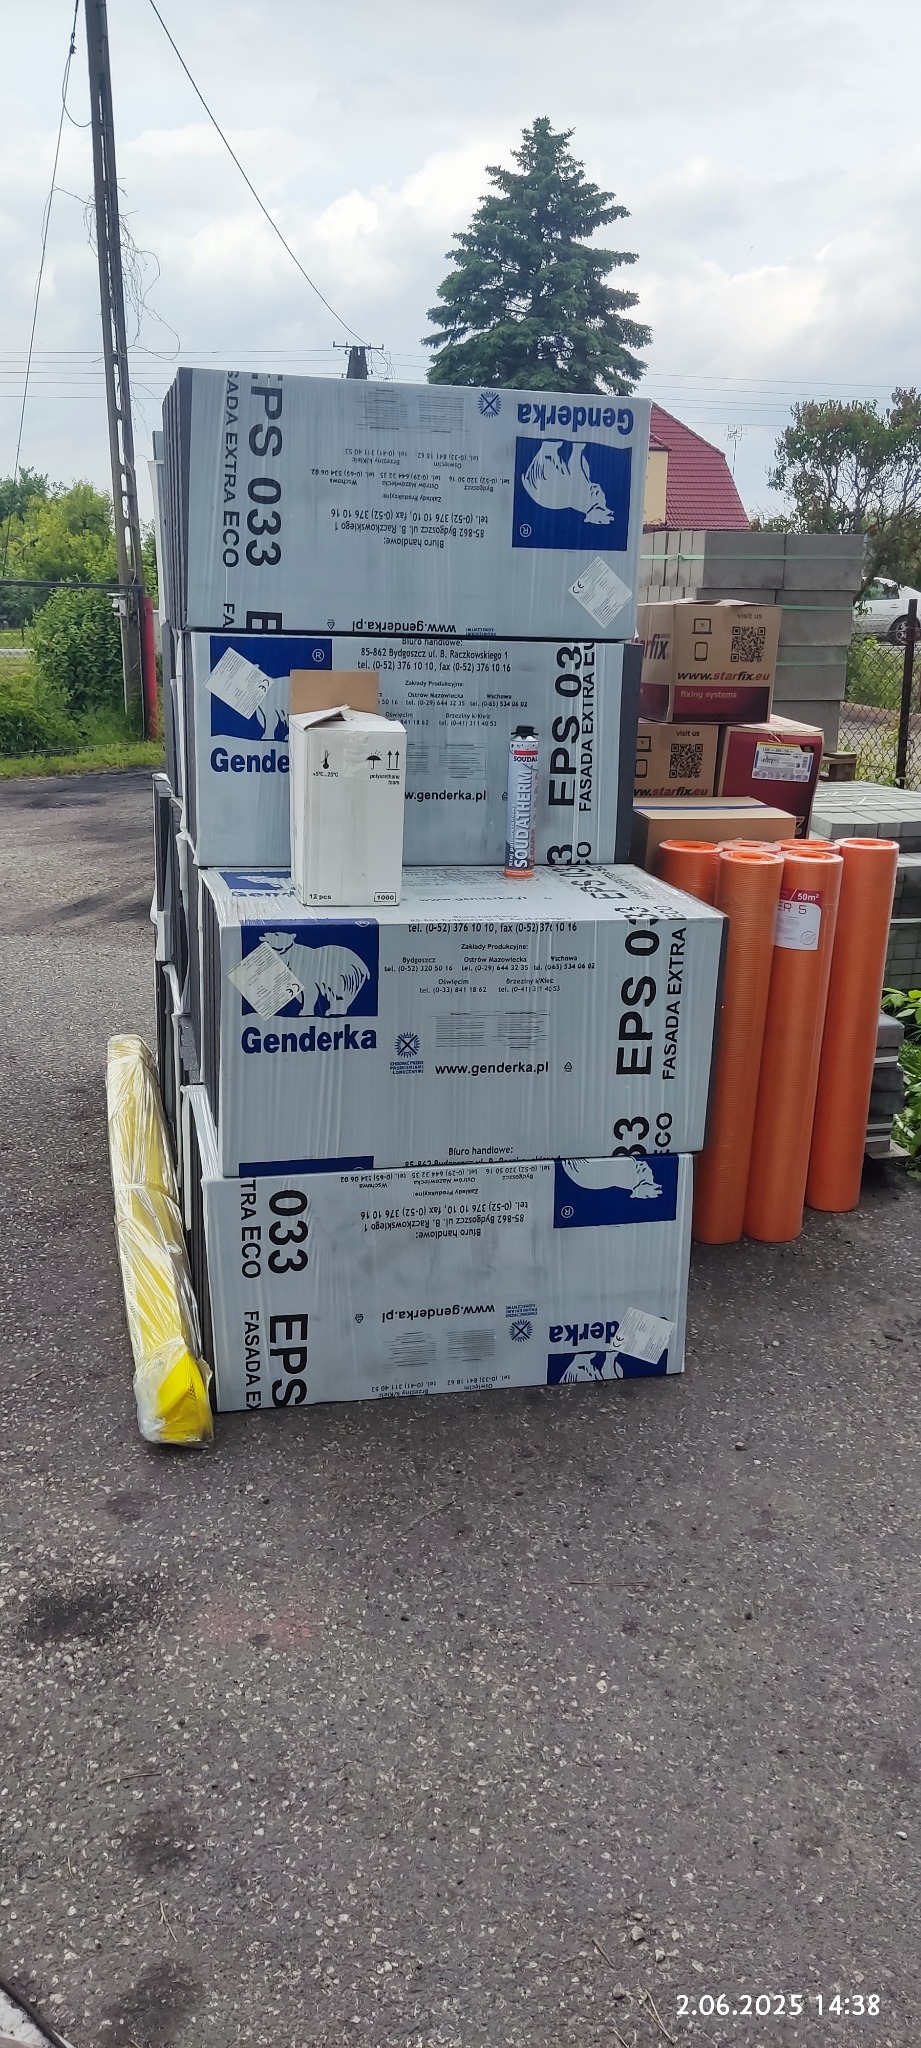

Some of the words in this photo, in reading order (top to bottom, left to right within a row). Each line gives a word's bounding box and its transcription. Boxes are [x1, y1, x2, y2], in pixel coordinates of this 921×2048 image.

[226, 371, 239, 425] SADA
[518, 403, 634, 436] Genderka
[224, 432, 238, 503] EXTRA
[331, 508, 340, 518] 16
[342, 509, 352, 518] 10
[354, 510, 368, 519] 376
[371, 510, 394, 520] (0-52)
[395, 511, 408, 521] fax
[409, 512, 422, 521] 10,
[424, 512, 434, 522] 10
[436, 513, 449, 522] 376
[246, 478, 282, 566] 033
[451, 513, 474, 524] (0-52)
[476, 515, 488, 524] tel.
[334, 522, 338, 531] 1
[341, 522, 396, 534] Raczkowskiego
[399, 526, 407, 534] B.
[409, 526, 419, 535] ul.
[420, 526, 457, 537] Bydgoszcz
[459, 528, 485, 538] 85-862
[222, 511, 240, 568] ECO
[383, 538, 422, 548] handlowe:
[424, 540, 444, 548] Biuro
[352, 619, 456, 633] www.genderka.pl
[424, 639, 463, 647] handlowe:
[632, 634, 669, 660] arfix
[361, 648, 386, 657] 85-862
[388, 649, 426, 658] Bydgoszcz
[428, 649, 437, 658] ul.
[440, 650, 448, 658] B.
[450, 650, 502, 660] Raczkowskiego
[504, 651, 508, 659] 1
[358, 660, 370, 670] tel.
[373, 661, 395, 670] (0-52)
[398, 661, 411, 670] 376
[414, 661, 423, 670] 10
[426, 662, 436, 671] 10,
[440, 662, 450, 671] fax
[453, 662, 474, 673] (0-52)
[477, 663, 489, 672] 376
[492, 663, 500, 672] 10
[503, 664, 511, 672] 16
[554, 646, 582, 698] 03
[677, 671, 770, 681] www.starfix.eu
[680, 690, 703, 698] fixing
[705, 691, 737, 699] systems
[582, 672, 595, 734] EXTRA
[210, 748, 290, 773] Gende
[514, 755, 538, 763] SOUDAL
[548, 715, 580, 806] EPS
[579, 738, 594, 812] FASADA
[404, 790, 486, 802] w.genderka.pl
[633, 787, 709, 797] ww.starfix.eu
[514, 770, 533, 869] SOUDATHERM
[797, 893, 819, 901] 50m²
[778, 901, 792, 912] ER
[408, 923, 422, 933] tel.
[425, 923, 450, 934] (0-52)
[453, 923, 468, 932] 376
[472, 923, 482, 932] 10
[484, 923, 497, 934] 10,
[500, 922, 513, 932] fax
[516, 922, 539, 934] (0-52)
[556, 922, 564, 932] 10
[568, 922, 577, 932] 16
[666, 927, 687, 996] EXTRA
[398, 965, 418, 973] (0-52)
[616, 975, 656, 1075] EPS
[241, 1024, 377, 1054] Genderka
[662, 1000, 680, 1080] FASADA
[435, 1062, 548, 1076] www.genderka.pl
[612, 1116, 650, 1156] 33
[449, 1148, 470, 1156] Biuro
[472, 1146, 514, 1155] handlowe:
[240, 1179, 256, 1221] TRA
[515, 1200, 528, 1209] tel.
[403, 1205, 426, 1216] (0-52)
[429, 1205, 442, 1214] fax
[445, 1204, 457, 1213] 10,
[460, 1204, 469, 1213] 10
[472, 1203, 486, 1212] 376
[489, 1201, 512, 1211] (0-52)
[360, 1211, 369, 1219] 16
[372, 1210, 382, 1219] 10
[385, 1208, 400, 1218] 376
[433, 1218, 440, 1227] B.
[444, 1218, 453, 1226] ul.
[456, 1215, 495, 1225] Bydgoszcz
[498, 1214, 524, 1223] 85-862
[364, 1223, 368, 1231] 1
[371, 1219, 430, 1231] Raczkowskiego
[268, 1189, 308, 1274] 033
[415, 1230, 458, 1239] handlowe:
[460, 1228, 481, 1236] Biuro
[242, 1226, 261, 1279] ECO
[382, 1304, 495, 1323] www.genderka.pl
[549, 1320, 620, 1346] derka
[244, 1311, 260, 1387] FASADA
[270, 1313, 308, 1408] EPS
